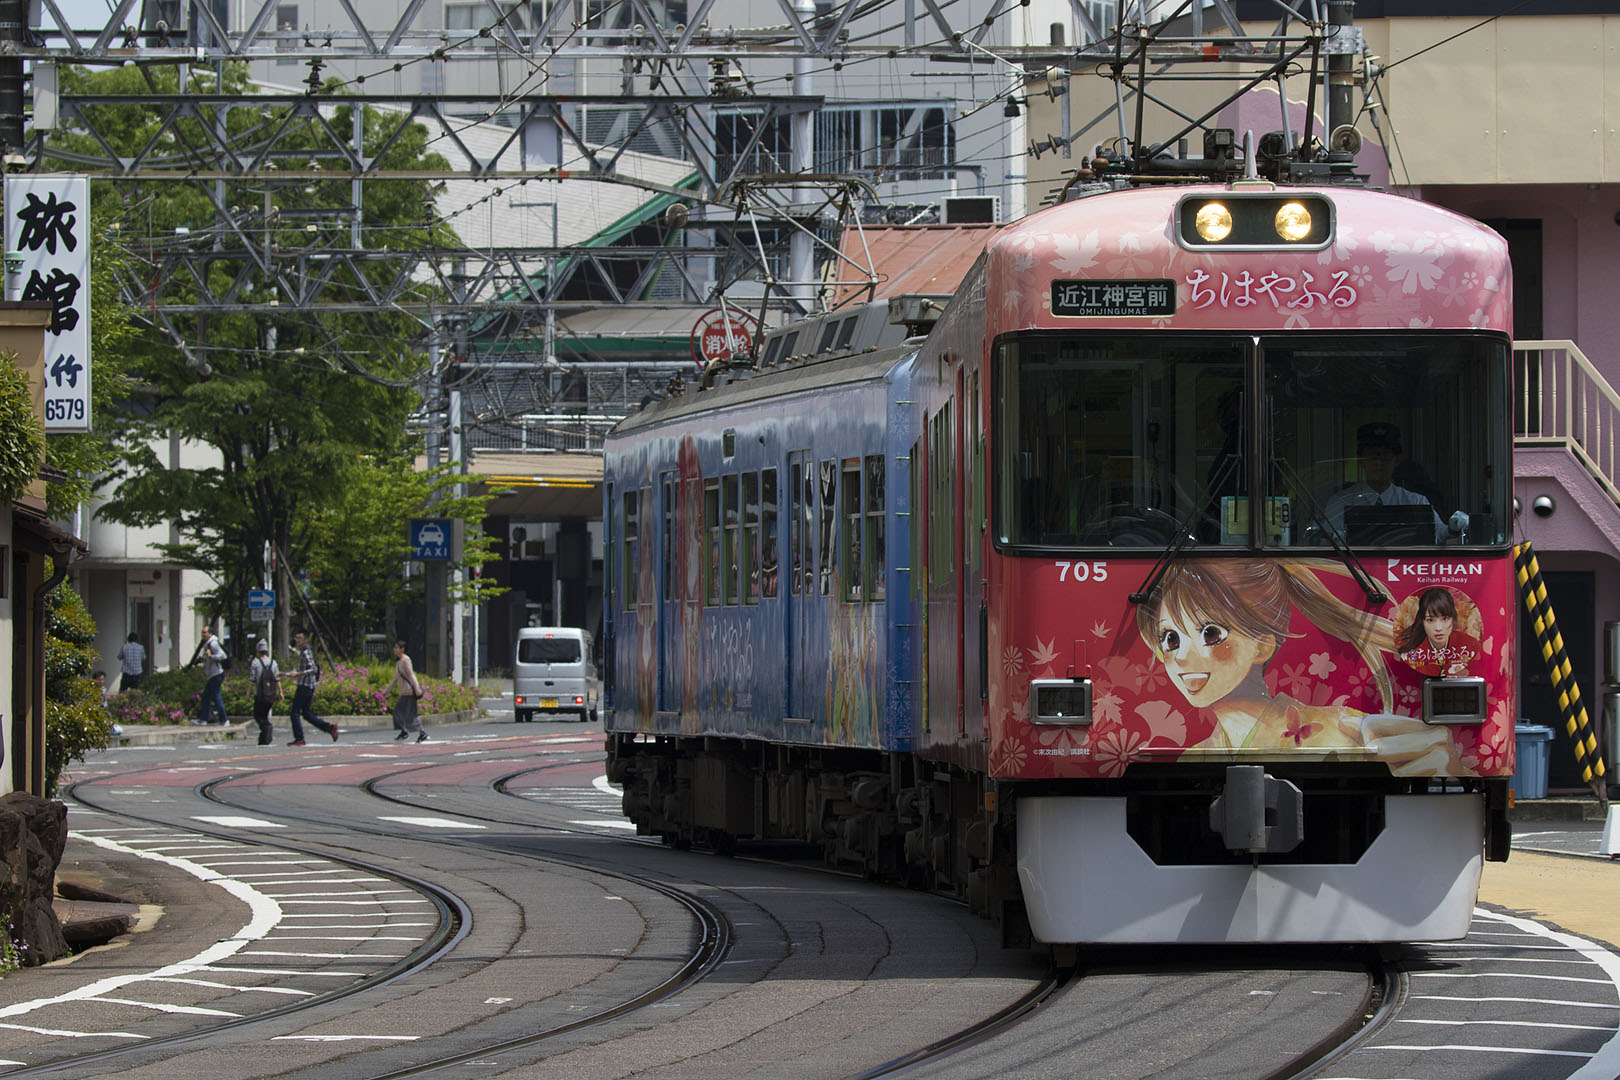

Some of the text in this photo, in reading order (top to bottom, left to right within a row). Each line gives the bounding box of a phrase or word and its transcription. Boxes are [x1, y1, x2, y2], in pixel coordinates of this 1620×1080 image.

[17, 192, 81, 336] 旅館
[1058, 284, 1169, 308] 近江神宮前
[1186, 270, 1357, 309] ちはやふる
[1079, 308, 1148, 316] OMIJINGUMAE
[44, 353, 83, 389] 竹
[45, 398, 84, 420] 6579
[416, 547, 448, 557] TAXI
[1055, 561, 1108, 582] 705
[1402, 562, 1483, 575] KEIHAN
[1441, 576, 1468, 584] Railway
[1416, 645, 1470, 661] ちはやふる
